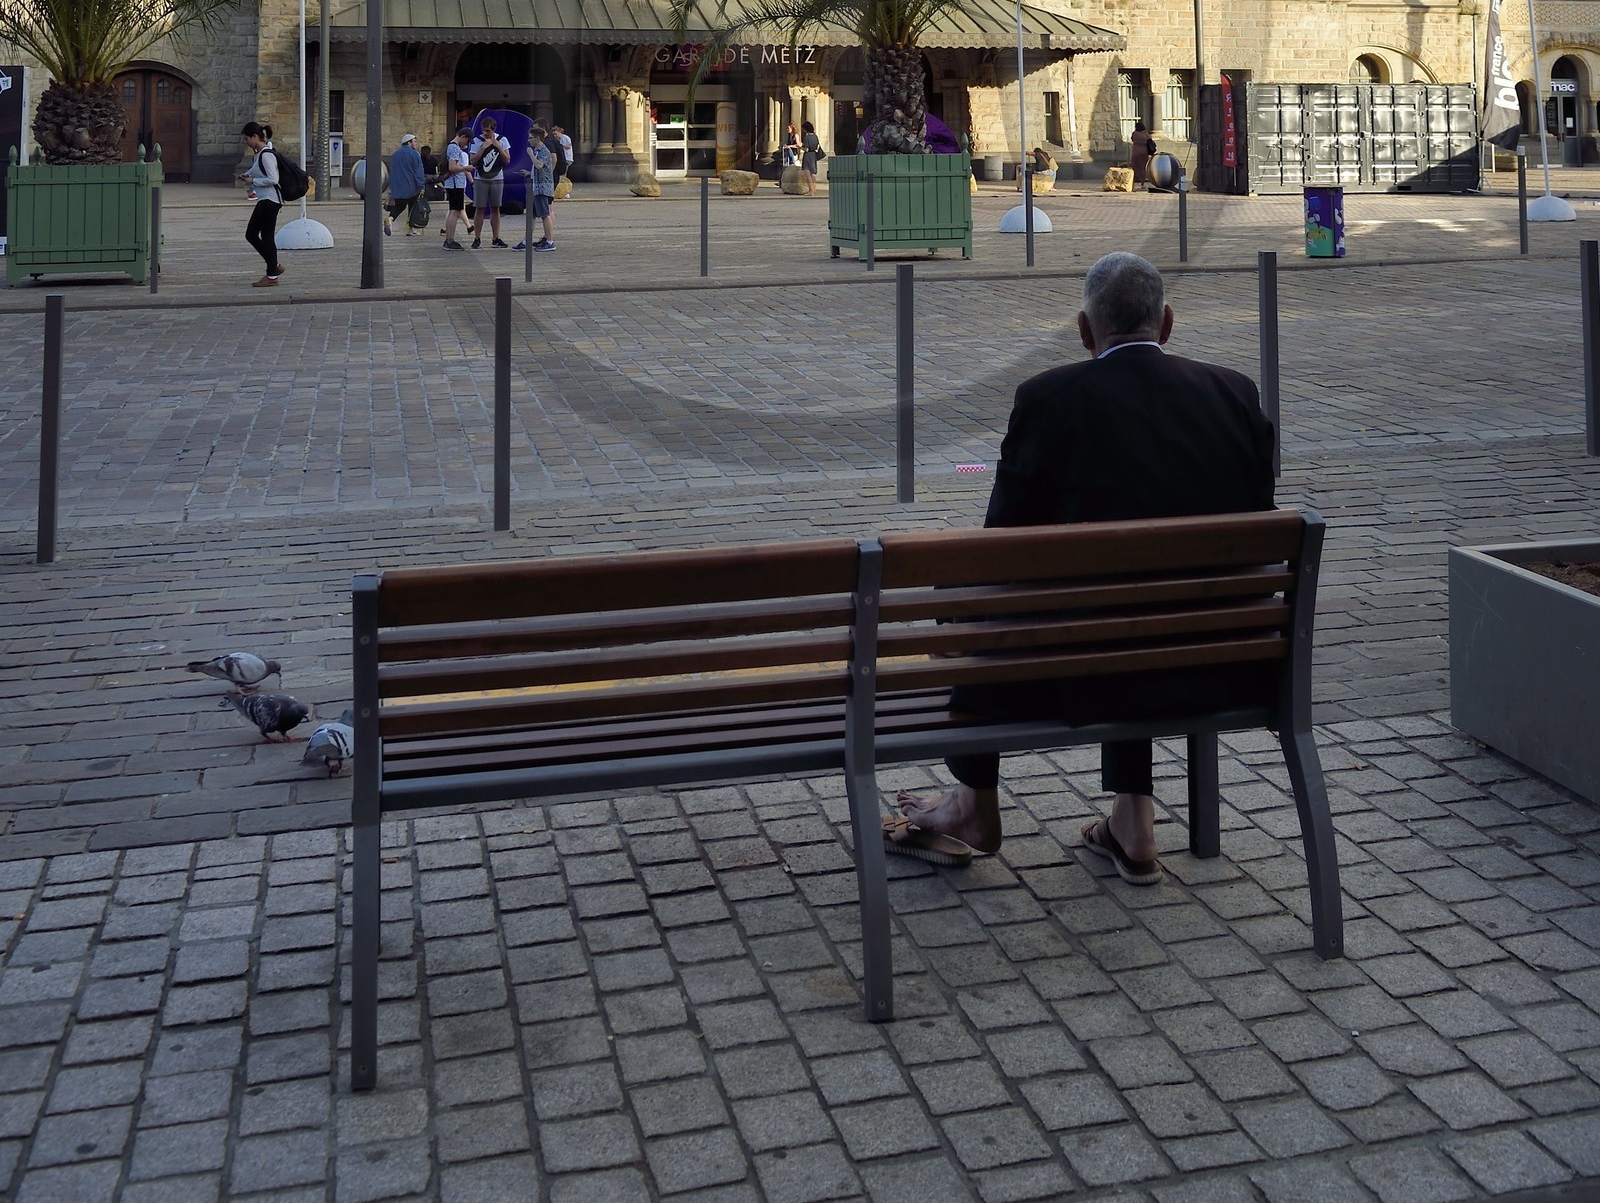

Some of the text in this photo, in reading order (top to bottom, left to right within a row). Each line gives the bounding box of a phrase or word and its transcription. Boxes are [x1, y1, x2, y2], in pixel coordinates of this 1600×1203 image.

[655, 47, 708, 63] GAR
[725, 47, 749, 63] DE
[761, 46, 815, 64] METZ
[1491, 35, 1504, 76] france
